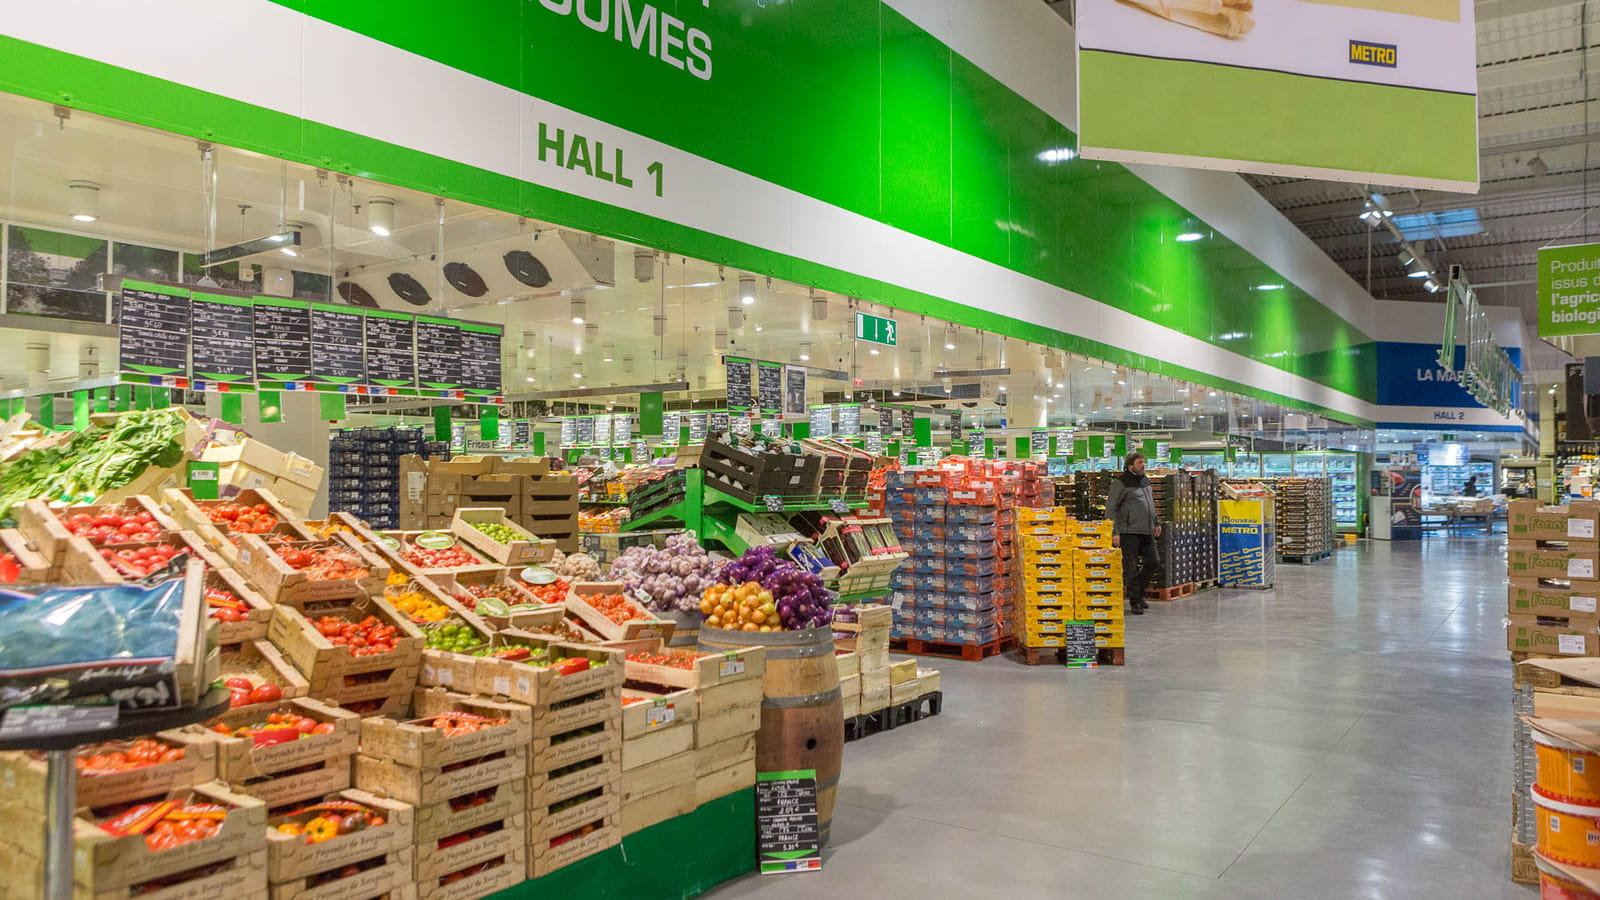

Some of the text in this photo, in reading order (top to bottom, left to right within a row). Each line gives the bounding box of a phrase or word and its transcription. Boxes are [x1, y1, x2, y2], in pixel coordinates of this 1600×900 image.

[538, 0, 712, 81] UMES
[1350, 44, 1396, 64] METRO
[538, 122, 663, 198] HALL 1
[1551, 258, 1600, 273] Produi
[1552, 272, 1600, 290] issus d
[1552, 290, 1600, 307] l'agric
[1552, 308, 1600, 324] biologi
[1417, 369, 1474, 383] LA MAR
[1434, 411, 1464, 420] HALL 2
[468, 440, 497, 448] Frites F
[1531, 631, 1559, 646] fann
